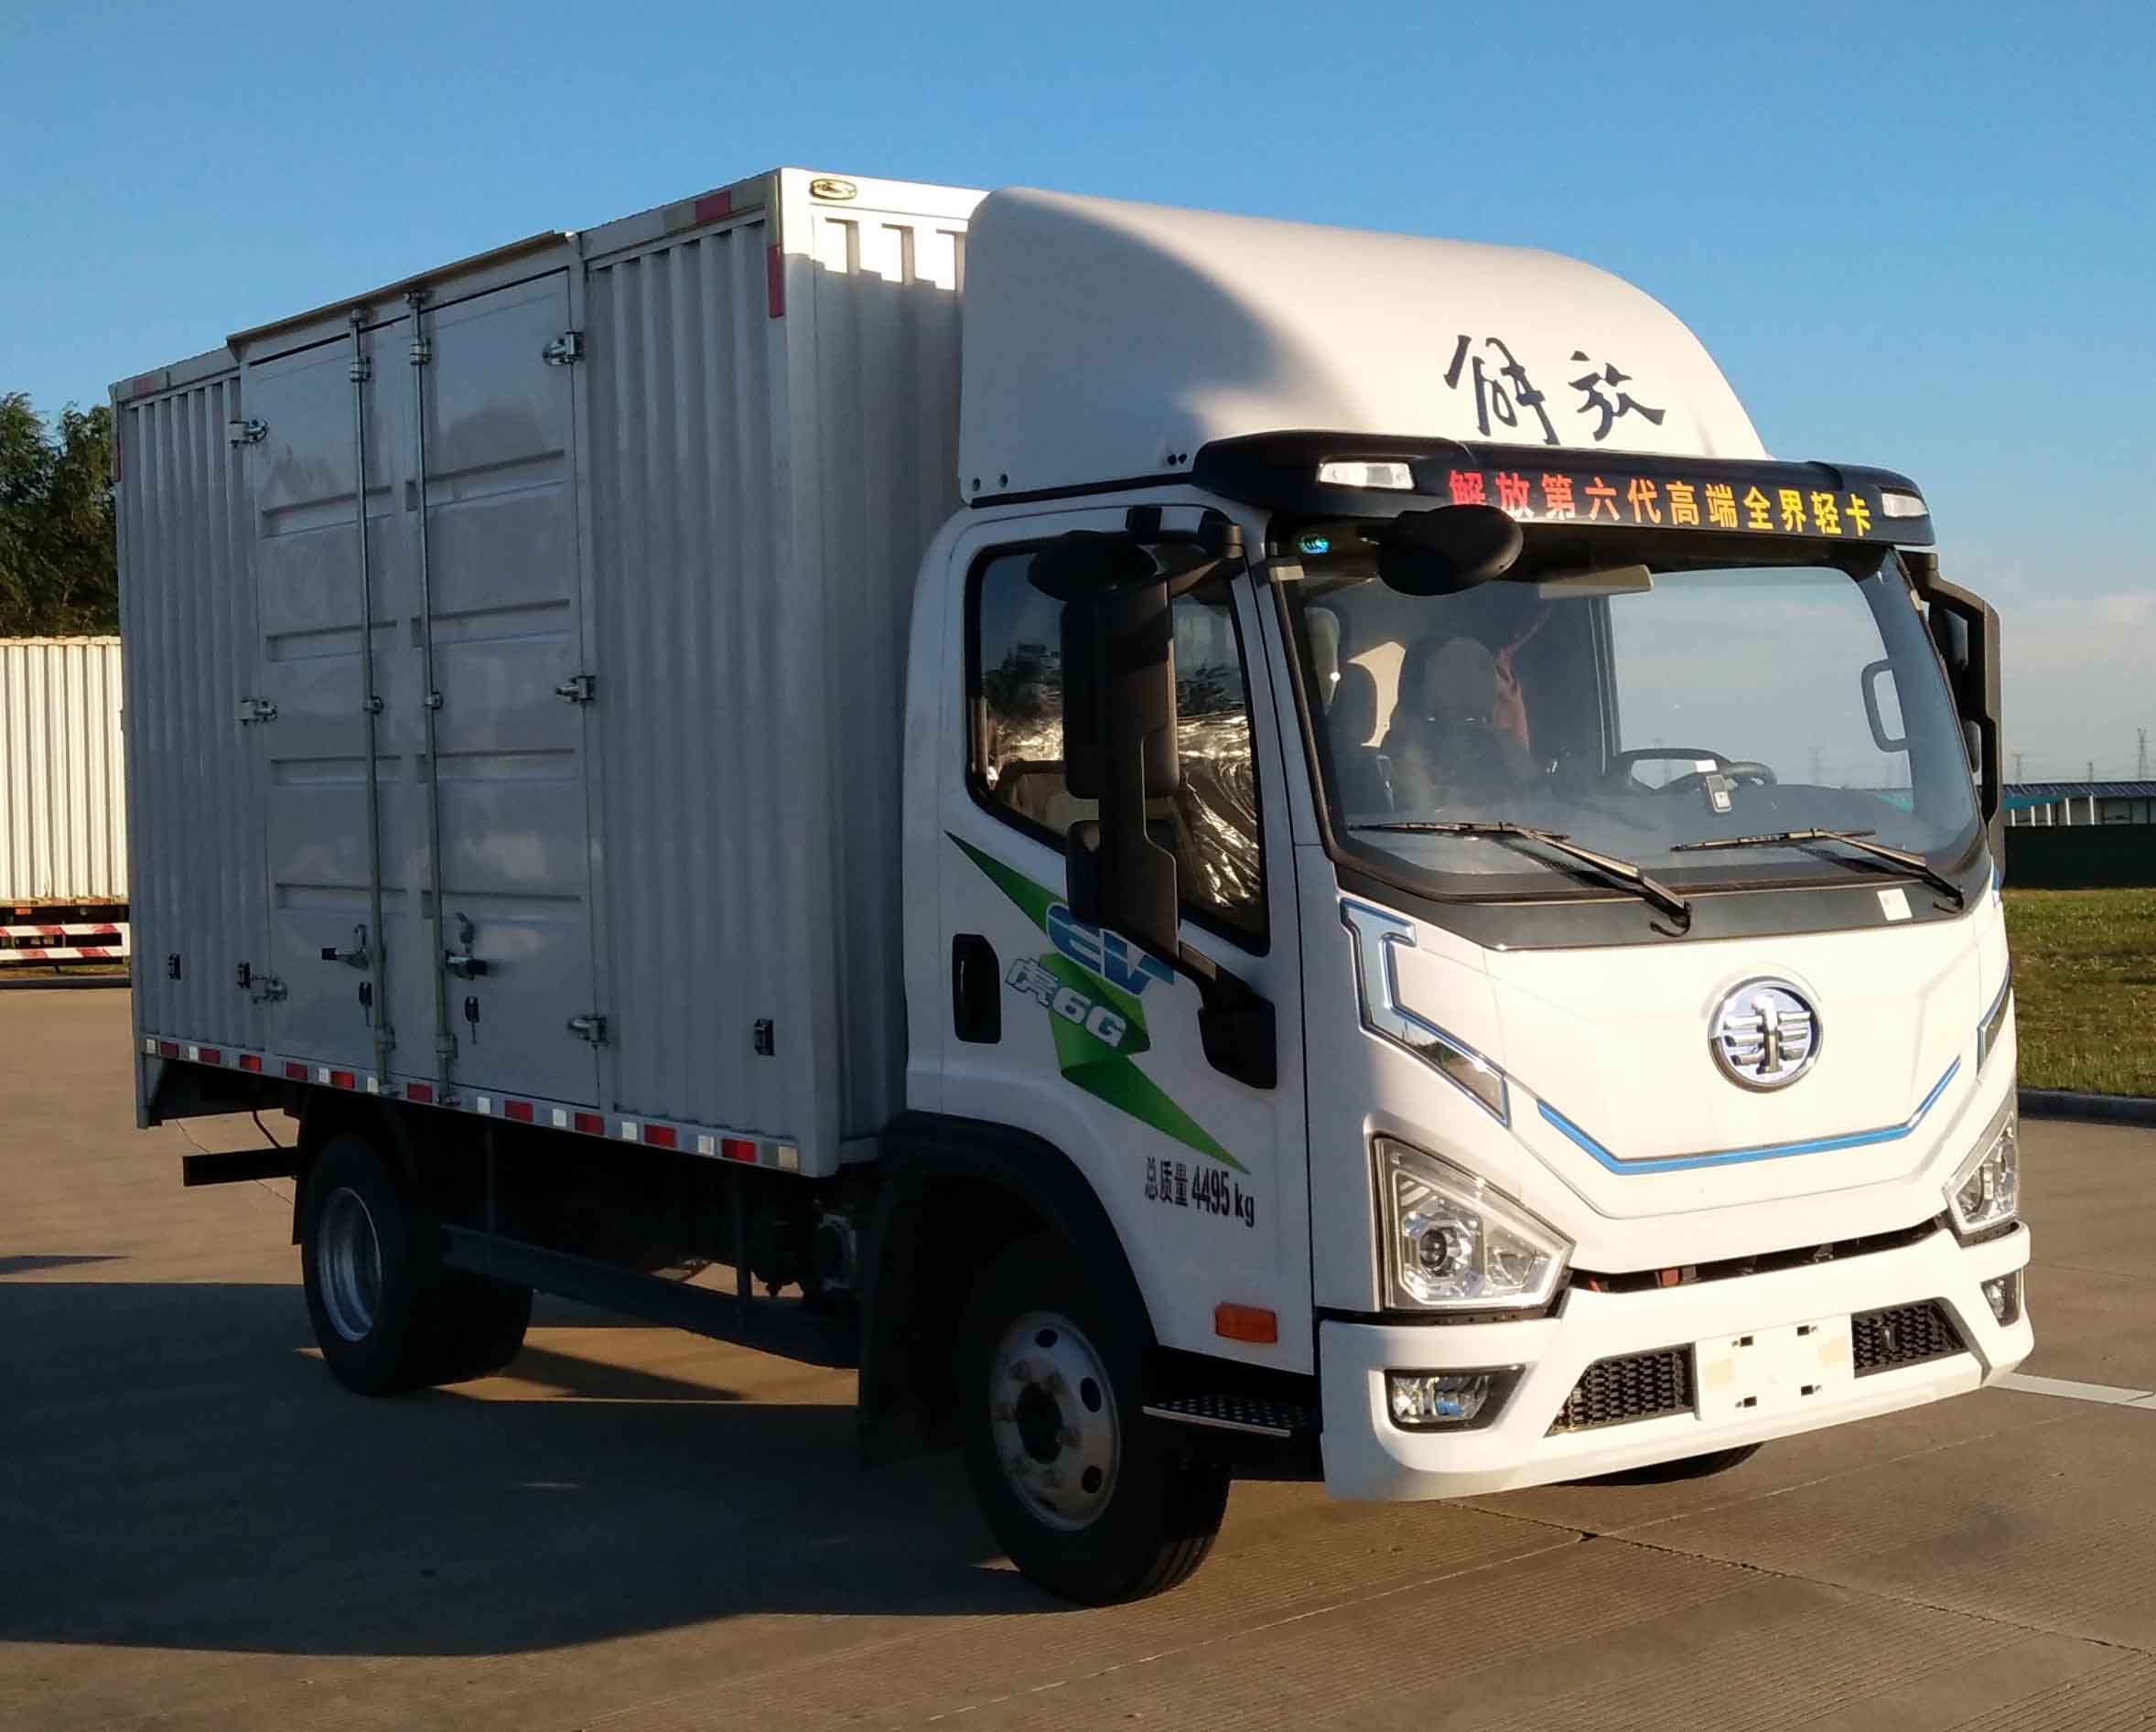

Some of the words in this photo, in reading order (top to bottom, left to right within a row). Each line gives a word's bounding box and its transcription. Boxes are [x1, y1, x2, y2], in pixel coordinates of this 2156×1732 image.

[1444, 335, 1666, 446] 解放
[1449, 468, 1872, 537] 解放第六代高端全界轻卡
[1144, 1156, 1188, 1207] 总质量
[1191, 1165, 1230, 1216] 4495
[1234, 1182, 1255, 1228] kg
